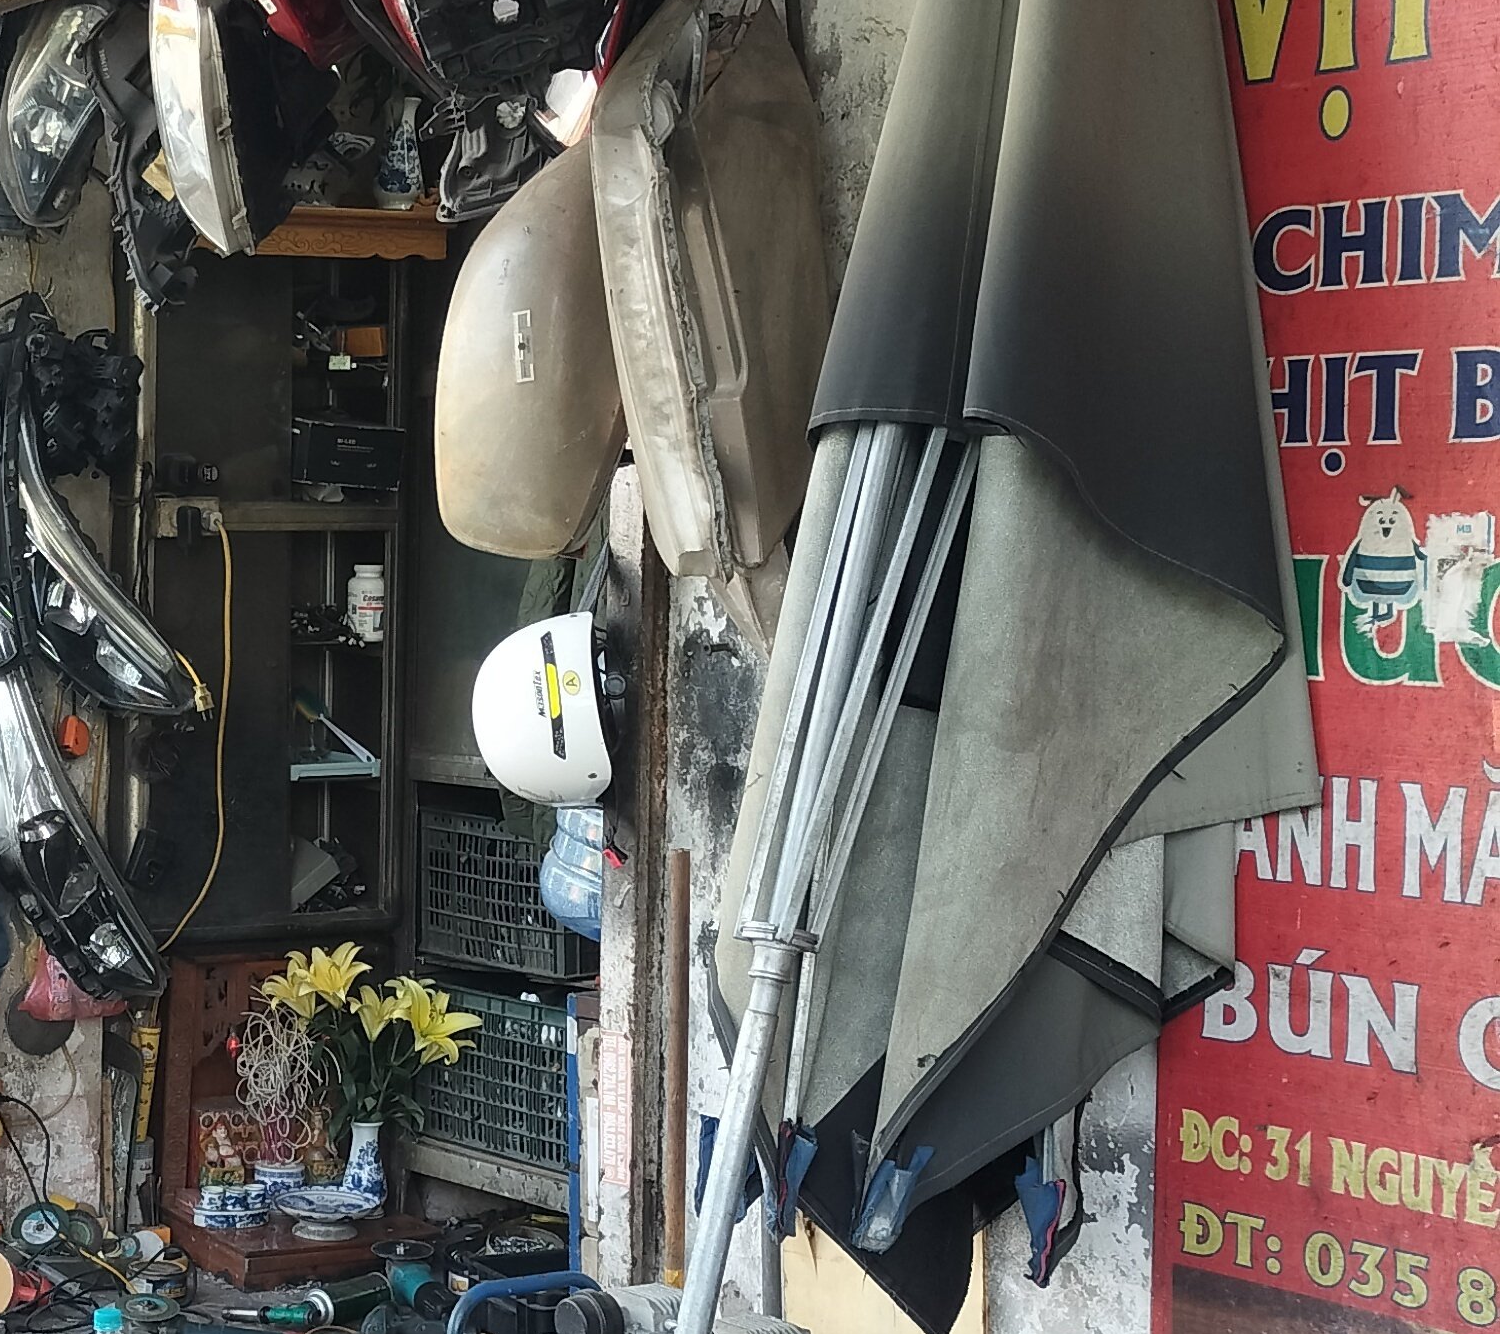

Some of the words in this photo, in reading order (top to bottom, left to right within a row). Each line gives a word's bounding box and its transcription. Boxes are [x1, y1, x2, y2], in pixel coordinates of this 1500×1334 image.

[1201, 948, 1421, 1075] BÚN
[1180, 1107, 1254, 1175] ĐC:
[1264, 1126, 1312, 1188] 31
[1179, 1201, 1283, 1276] ĐT:
[1302, 1230, 1430, 1310] 035
